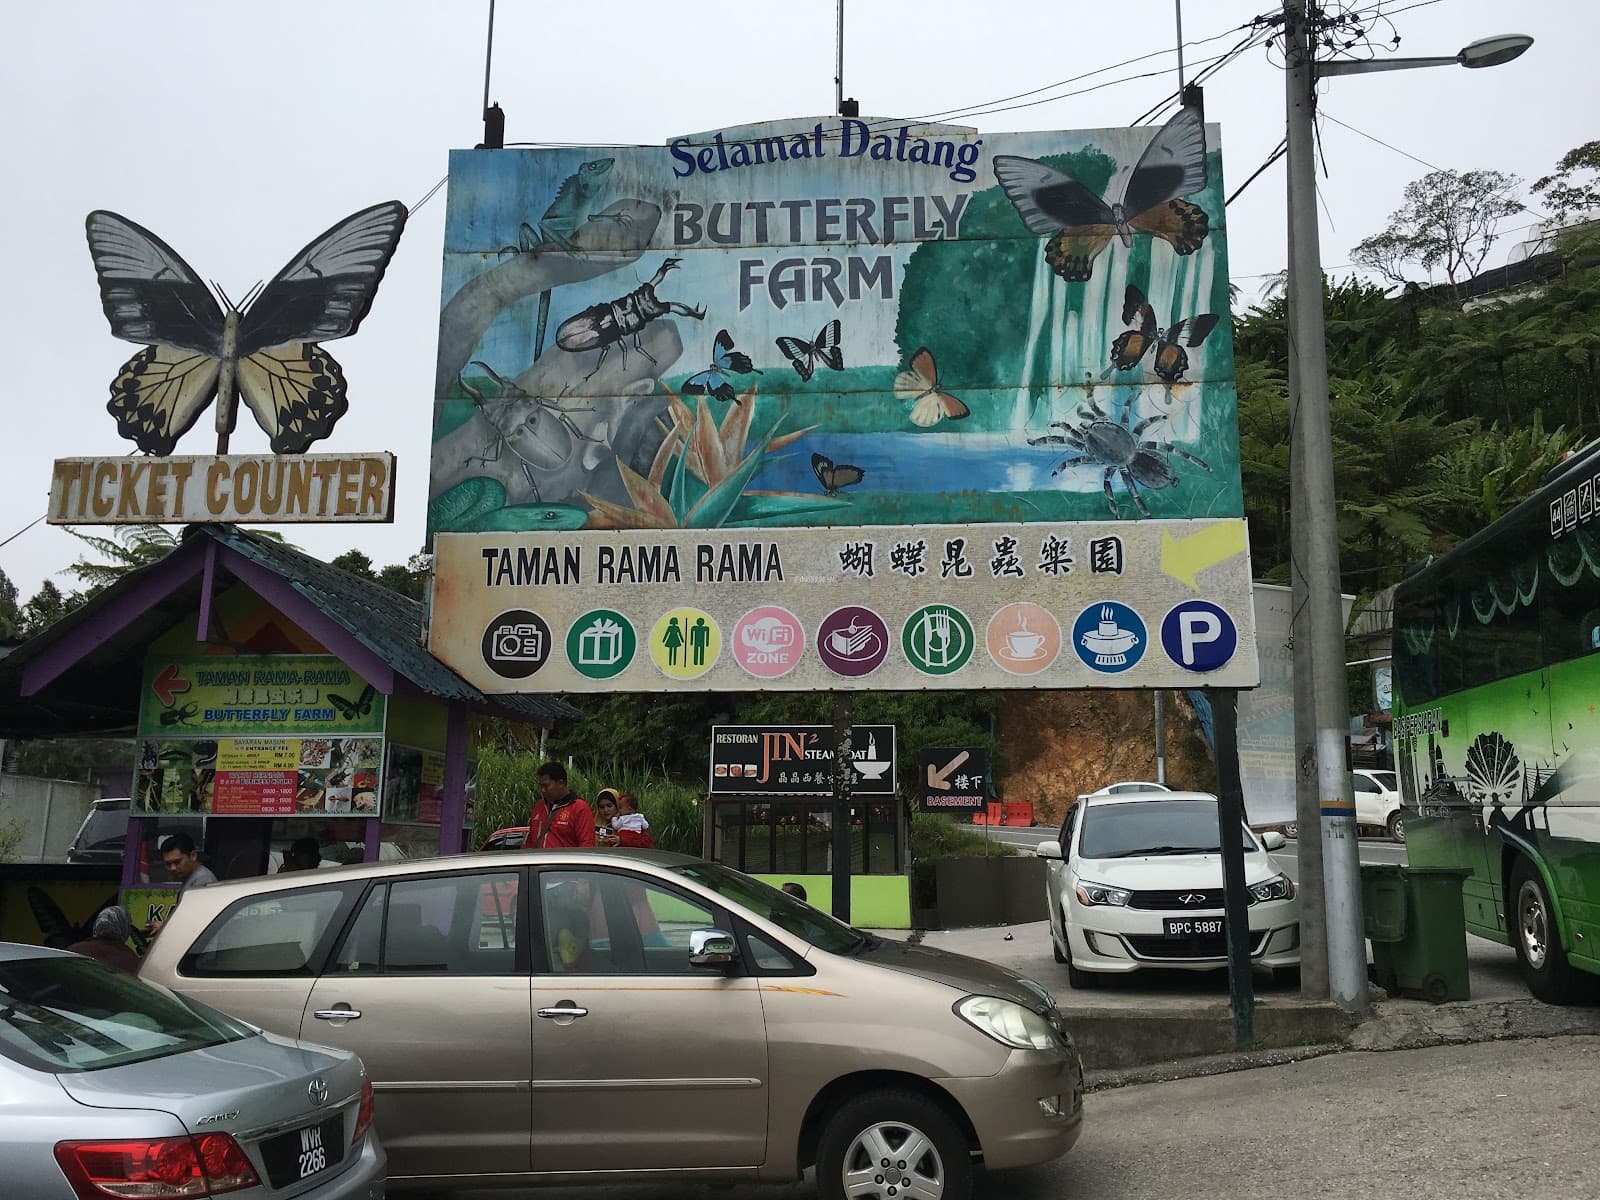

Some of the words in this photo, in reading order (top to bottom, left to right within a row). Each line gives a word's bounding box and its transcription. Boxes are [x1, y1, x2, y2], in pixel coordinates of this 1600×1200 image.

[670, 122, 827, 179] Selamat
[838, 119, 984, 184] Datang
[673, 193, 969, 247] BUTTERFLY
[739, 255, 893, 312] FARM
[55, 461, 193, 518] TICKET
[206, 458, 387, 517] COUNTER
[482, 546, 581, 586] TAMAN
[597, 544, 681, 584] RAMA
[696, 543, 784, 582] RAMA
[1179, 611, 1222, 665] P
[747, 652, 789, 664] ZONE
[196, 670, 249, 686] TAMAN
[253, 670, 350, 686] RAMA-RAMA
[204, 708, 290, 722] BUTTERFLY
[294, 708, 337, 722] FARM
[716, 733, 759, 744] RESTORAN
[756, 732, 807, 784] JIN
[955, 774, 983, 789] 楼下
[926, 795, 983, 806] BASEMENT
[1169, 922, 1192, 934] BPC
[1194, 921, 1222, 933] 5887
[300, 1126, 322, 1152] WVR
[299, 1147, 326, 1178] 2266
